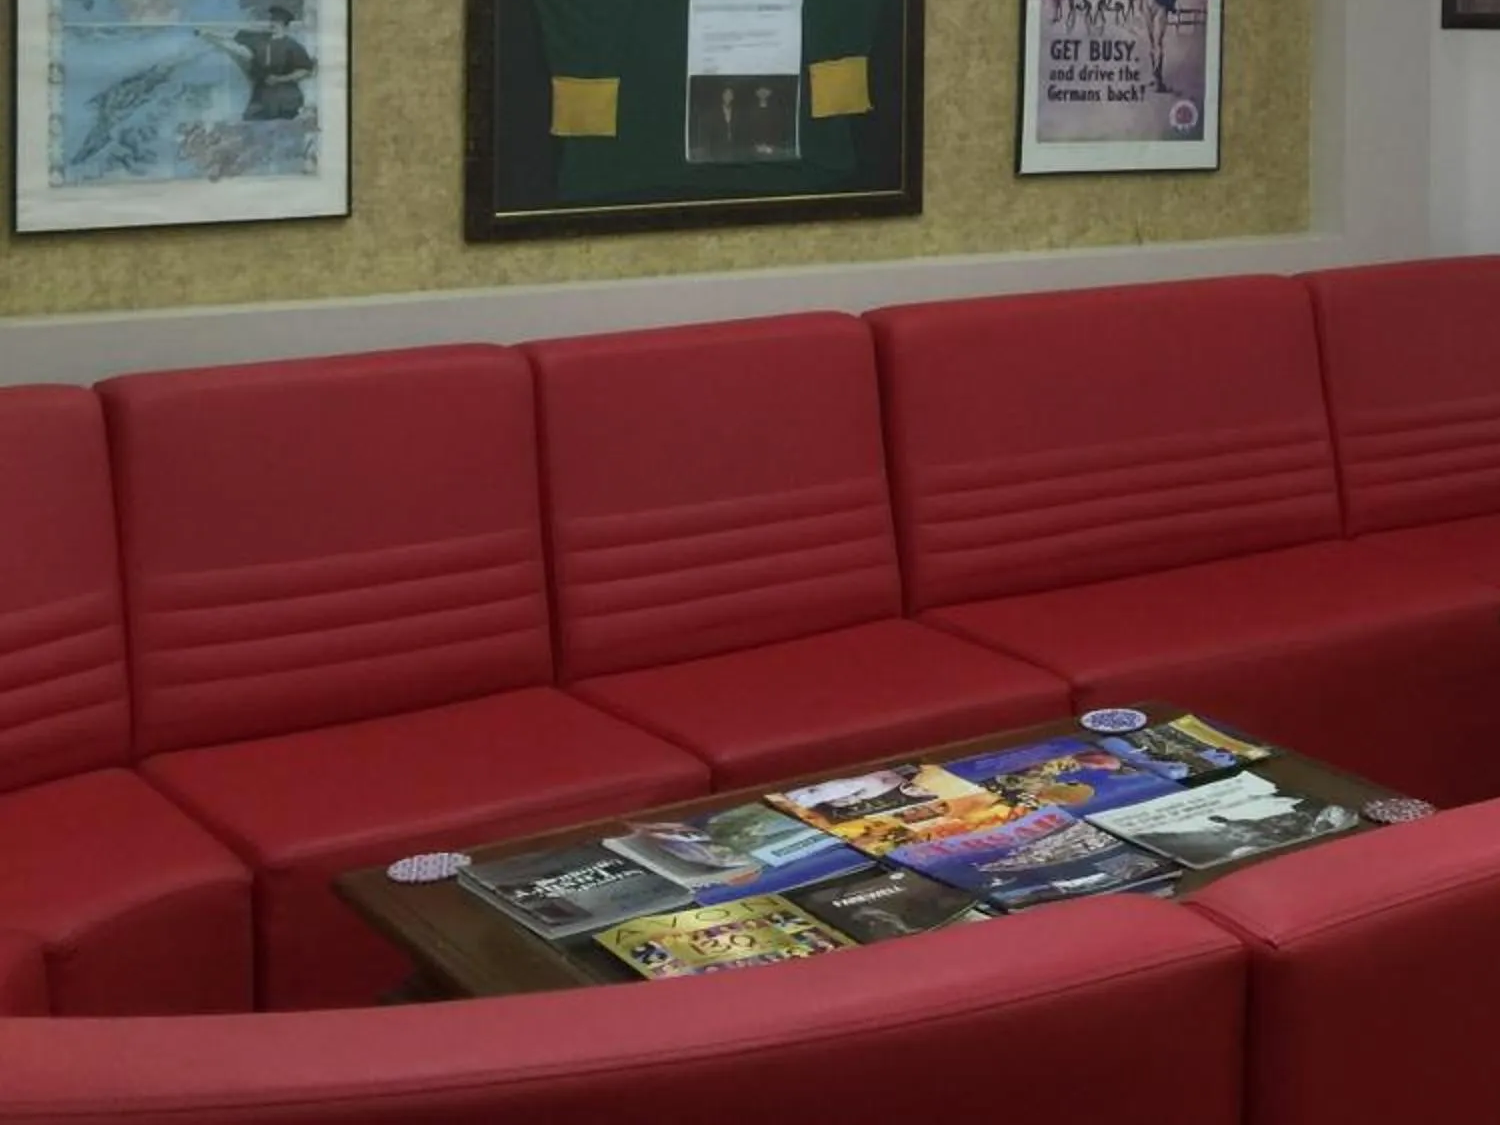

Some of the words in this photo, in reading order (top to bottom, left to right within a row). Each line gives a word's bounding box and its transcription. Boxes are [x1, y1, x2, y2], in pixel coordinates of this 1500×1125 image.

[1050, 38, 1083, 62] GET
[1049, 64, 1075, 81] and
[1078, 64, 1115, 81] drive
[1118, 64, 1141, 82] the
[1047, 83, 1102, 103] Germans
[1107, 84, 1147, 104] back!
